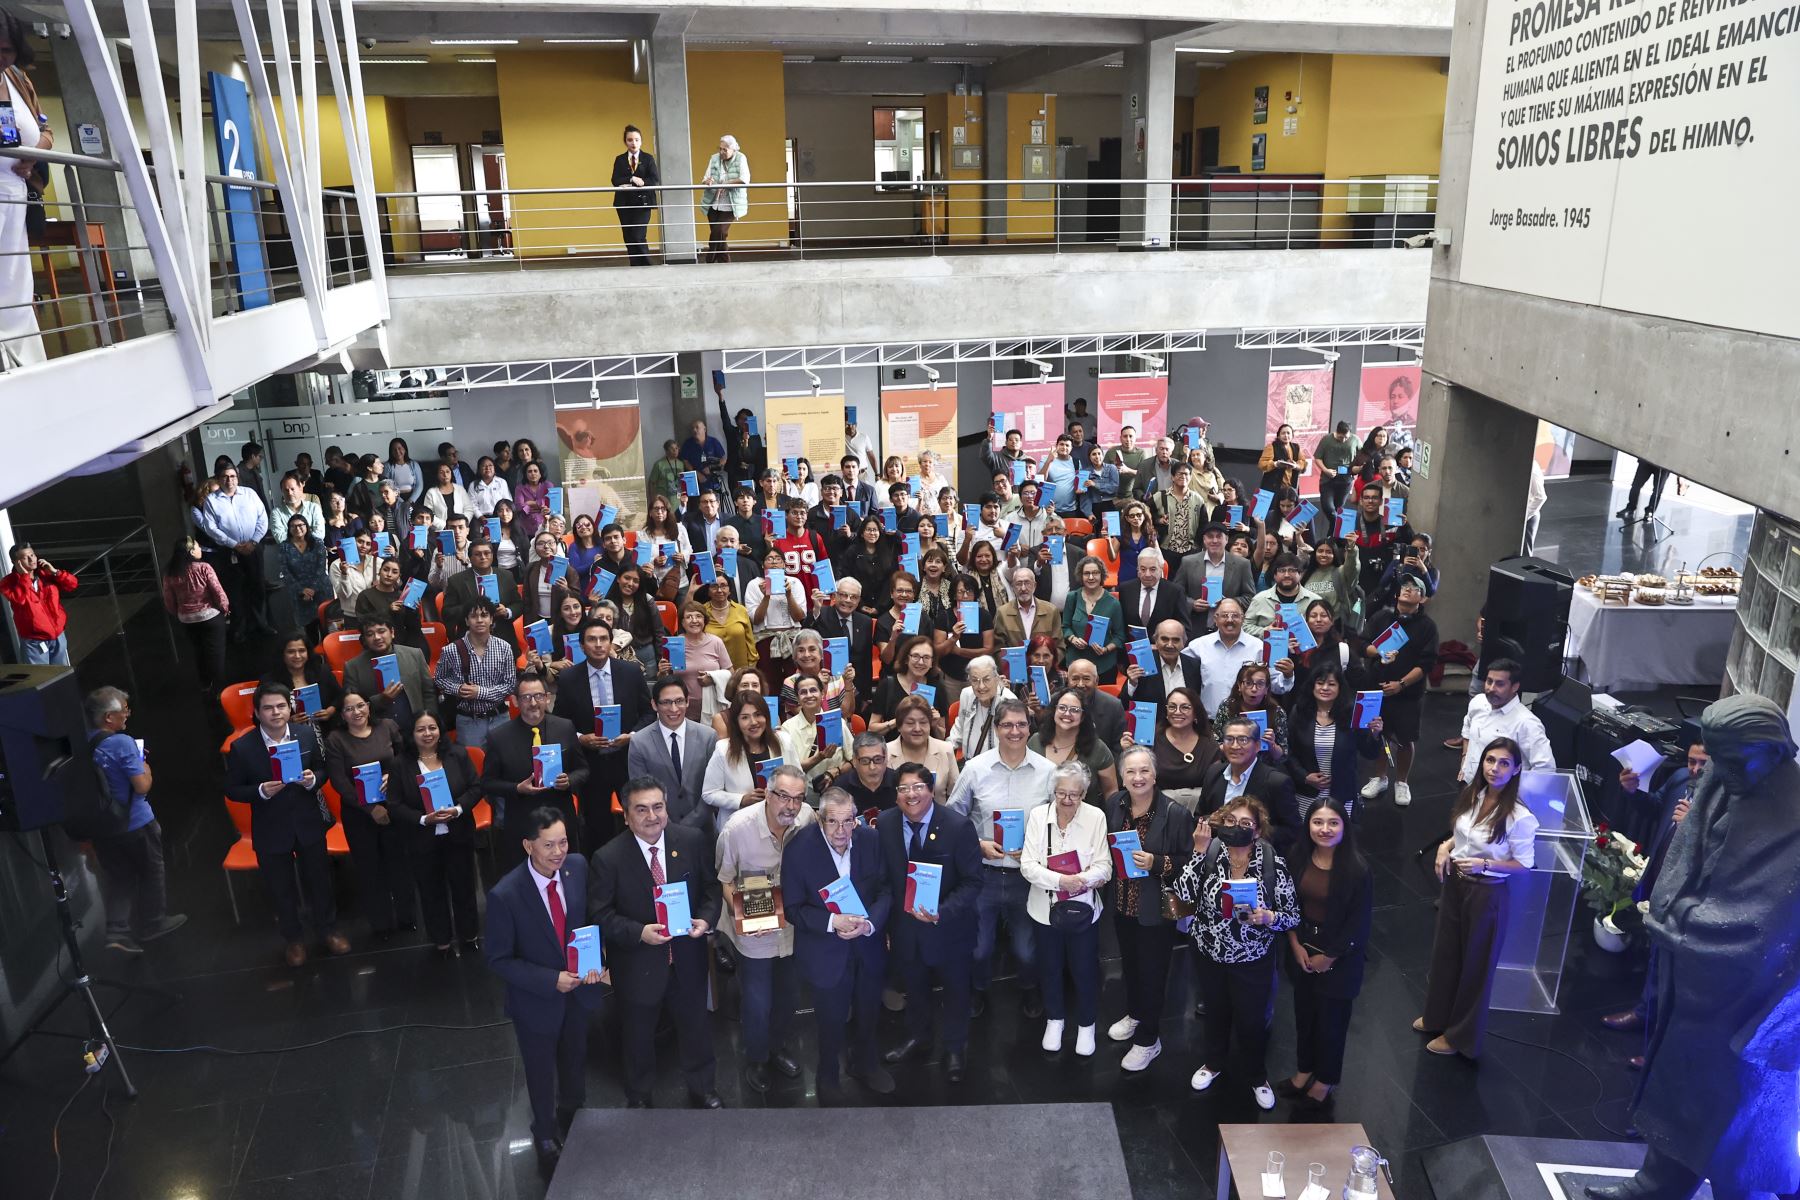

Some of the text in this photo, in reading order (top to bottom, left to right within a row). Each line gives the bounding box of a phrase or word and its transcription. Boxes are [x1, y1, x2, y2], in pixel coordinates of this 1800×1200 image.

[1506, 56, 1515, 74] EL
[1517, 37, 1573, 70] PROFUNDO
[1576, 10, 1651, 53] CONTENIDO
[1656, 2, 1677, 29] DE
[1503, 75, 1544, 101] HUMANA
[1547, 67, 1570, 91] QUE
[1571, 54, 1619, 85] ALIENTA
[1623, 47, 1643, 72] EN
[1646, 43, 1661, 67] EL
[1665, 30, 1710, 62] IDEAL
[1501, 56, 1768, 128] Y QUE TIENE SU MÁXIMA EXPRESIÓN EN EL
[224, 119, 243, 178] 2
[1496, 115, 1755, 171] SOMOS LIBRES DEL HIMNO.
[1489, 207, 1591, 231] Jorge Basadre. 1945
[207, 425, 236, 440] bnp
[282, 421, 310, 435] bnp
[1423, 446, 1429, 463] S
[784, 549, 817, 574] 99
